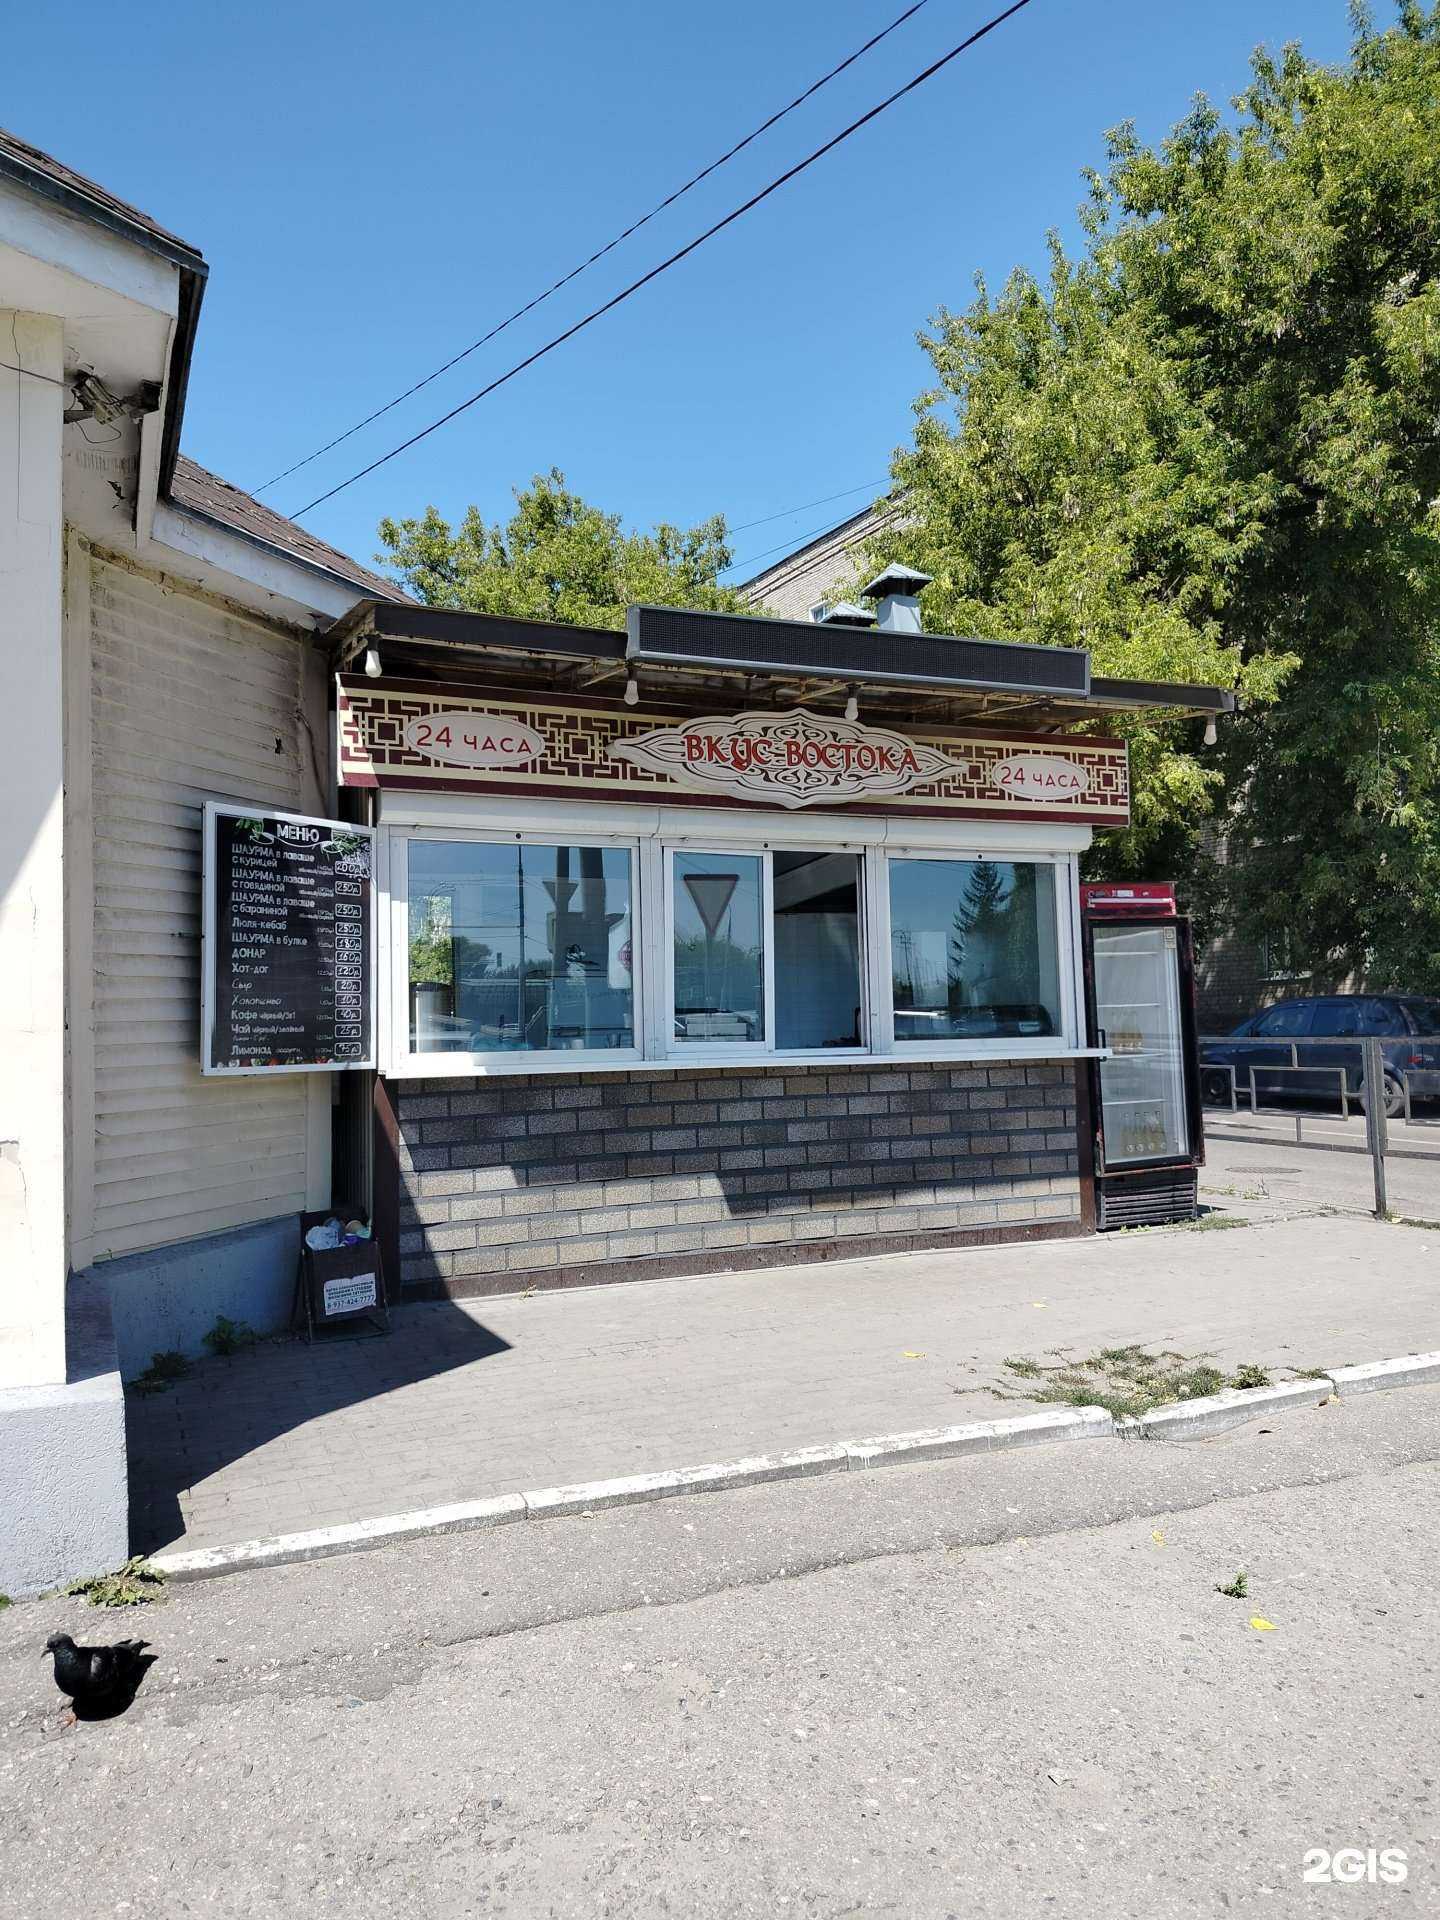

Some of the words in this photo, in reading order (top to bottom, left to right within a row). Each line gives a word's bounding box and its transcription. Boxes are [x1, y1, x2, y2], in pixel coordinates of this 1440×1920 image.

[417, 725, 452, 748] 24
[463, 735, 532, 754] ЧАСА
[683, 735, 772, 772] ВКУС
[784, 740, 922, 776] ВОСТОКА
[1001, 766, 1026, 785] 24
[1032, 772, 1081, 788] ЧАСА
[276, 824, 320, 843] МЕНЮ
[232, 843, 275, 858] ШАУРМА
[283, 851, 315, 862] лаваше
[239, 856, 278, 868] курицей
[232, 867, 275, 882] ШАУРМА
[283, 874, 315, 885] лаваше
[239, 881, 285, 892] говядиной
[232, 891, 275, 905] ШАУРМА
[283, 897, 316, 908] лаваше
[239, 904, 288, 916] бараниной
[232, 917, 287, 930] Люля-кебаб
[232, 932, 275, 945] ШАУРМА
[282, 935, 308, 947] булке
[232, 948, 266, 959] ДОНАР
[232, 962, 270, 974] Хот-дог
[231, 978, 253, 992] Сыр
[231, 1009, 258, 1021] Кофе
[231, 1023, 251, 1034] Чай
[231, 1044, 272, 1056] Лимонад
